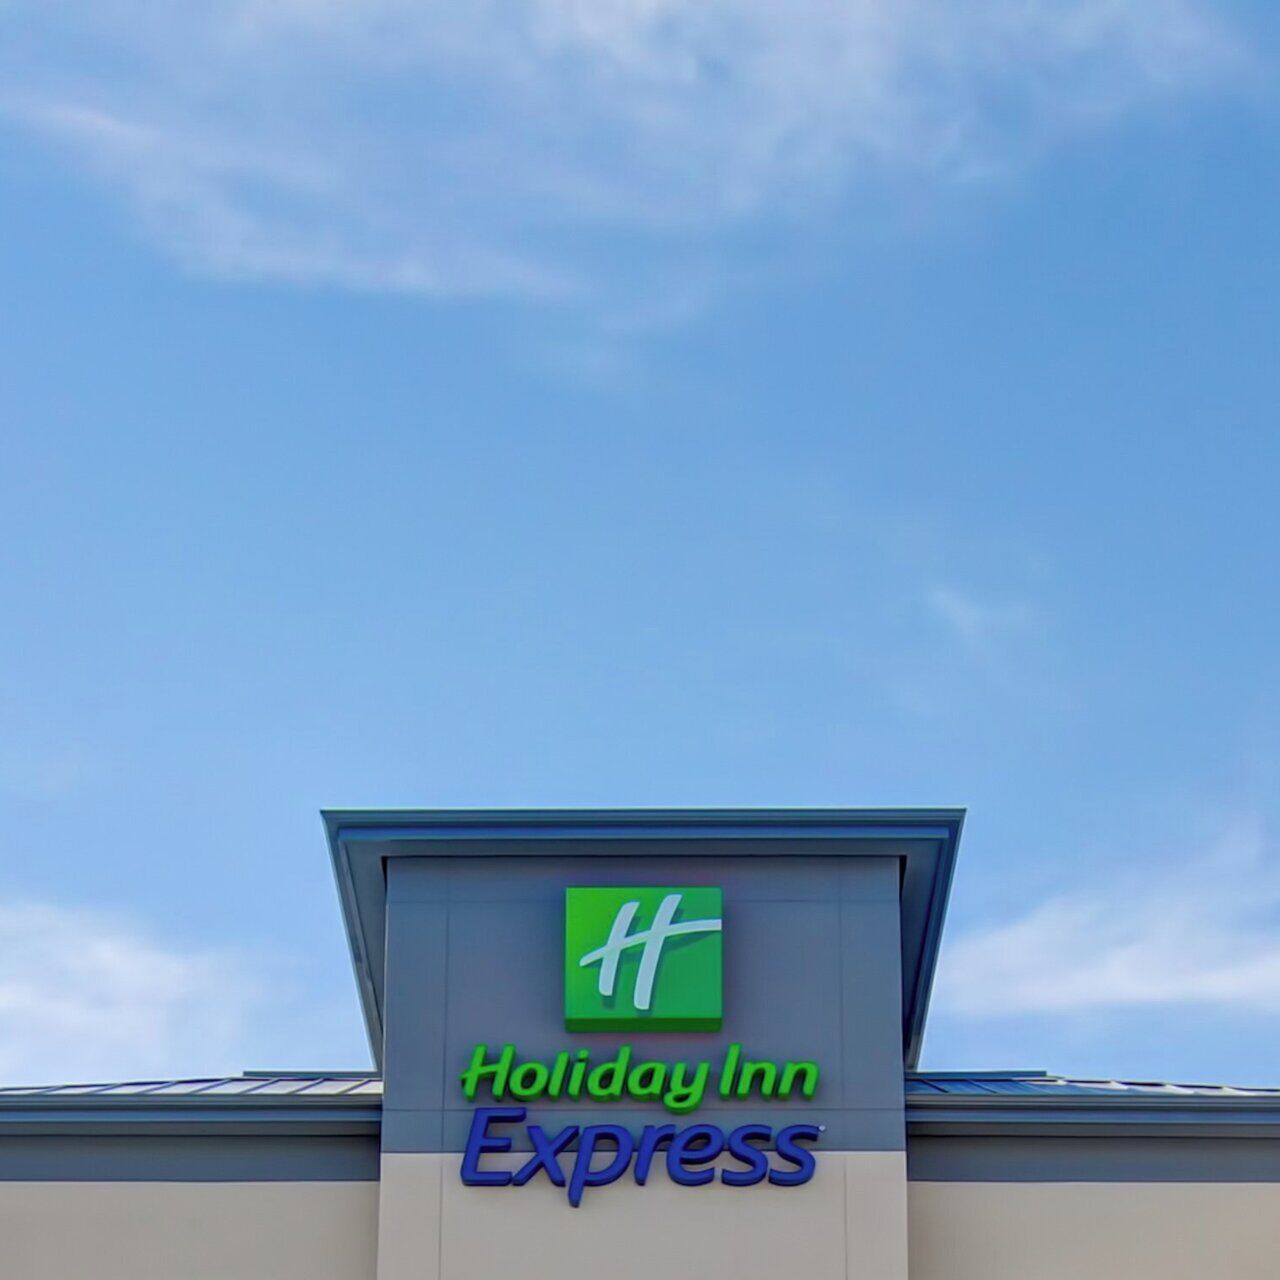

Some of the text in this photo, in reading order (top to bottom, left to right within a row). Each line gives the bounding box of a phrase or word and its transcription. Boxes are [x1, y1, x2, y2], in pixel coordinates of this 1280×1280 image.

[459, 1043, 820, 1114] Holiday Inn
[460, 1106, 821, 1208] Express
